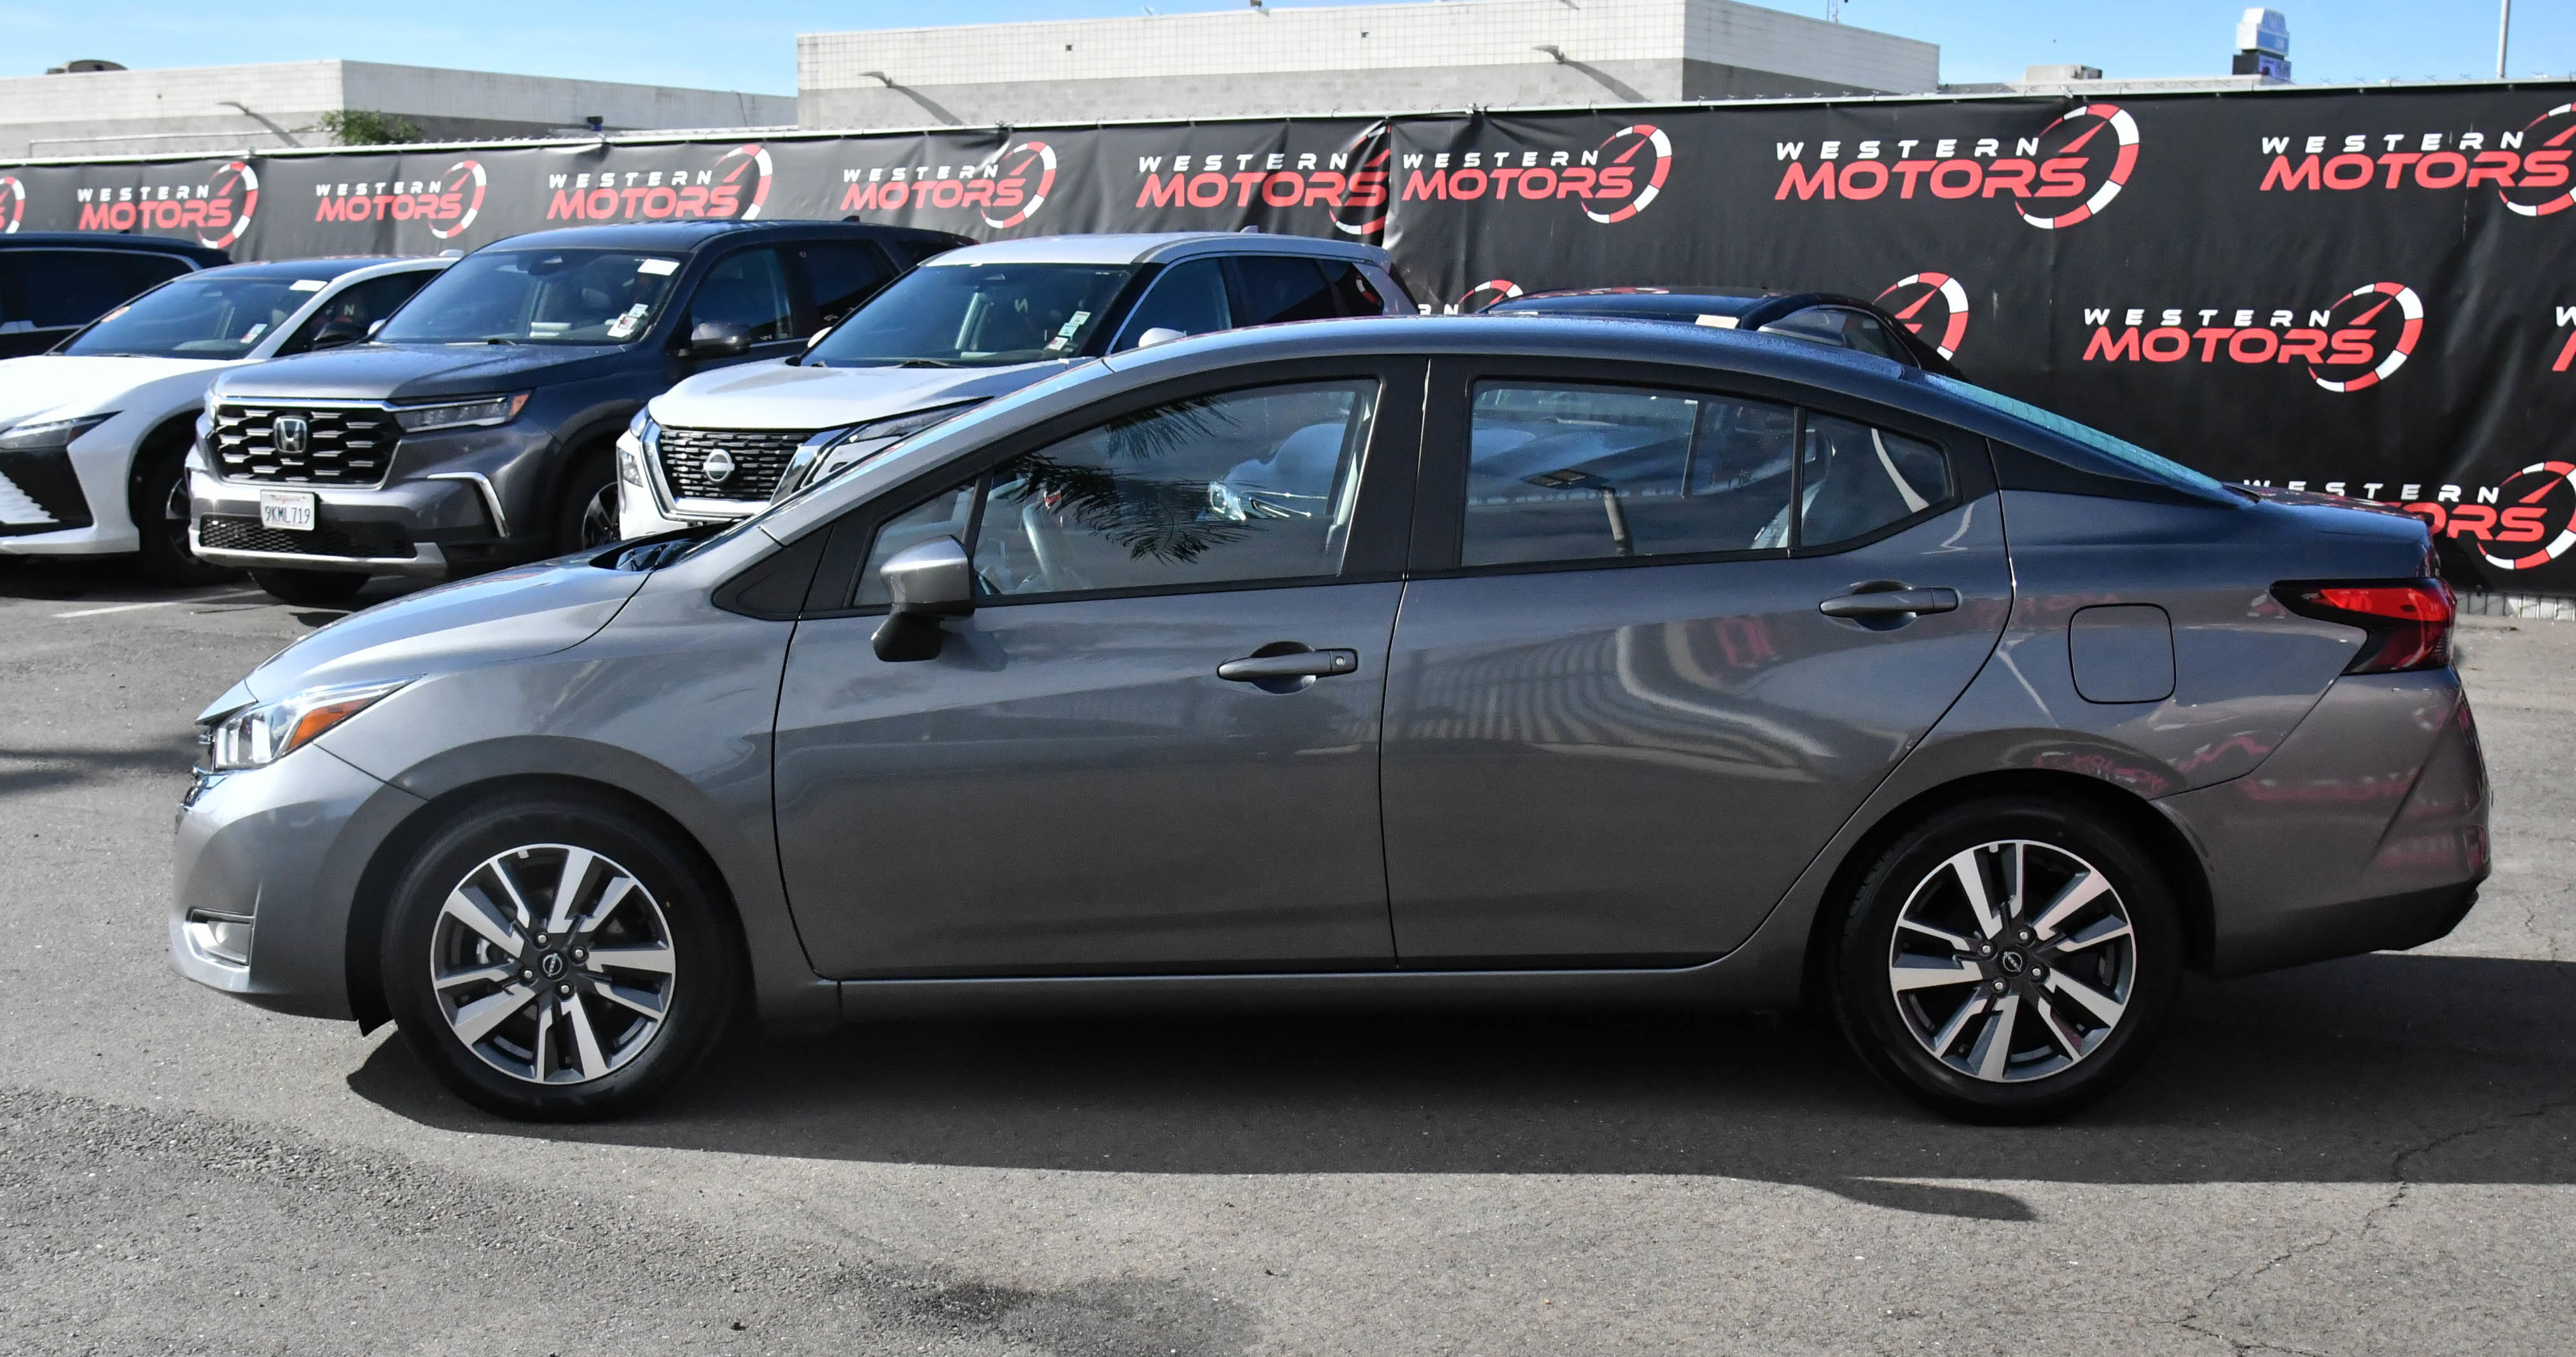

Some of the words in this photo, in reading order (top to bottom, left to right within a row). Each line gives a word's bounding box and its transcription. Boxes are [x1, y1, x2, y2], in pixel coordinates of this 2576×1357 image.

[1776, 137, 2039, 161] WESTERN
[2262, 131, 2524, 155] WESTERN
[1139, 152, 1348, 174] WESTERN
[1402, 150, 1599, 169] WESTERN
[2259, 150, 2573, 191] MOTORS
[548, 170, 712, 189] WESTERN
[843, 164, 999, 183] WESTERN
[1402, 165, 1635, 202] MOTORS
[1774, 157, 2089, 201] MOTORS
[77, 184, 209, 202] WESTERN
[315, 181, 441, 197] WESTERN
[546, 185, 741, 219] MOTORS
[840, 178, 1026, 211] MOTORS
[1135, 170, 1390, 209] MOTORS
[78, 198, 233, 231] MOTORS
[315, 193, 463, 222] MOTORS
[2084, 309, 2330, 327] WESTERN
[2083, 326, 2377, 365] MOTORS
